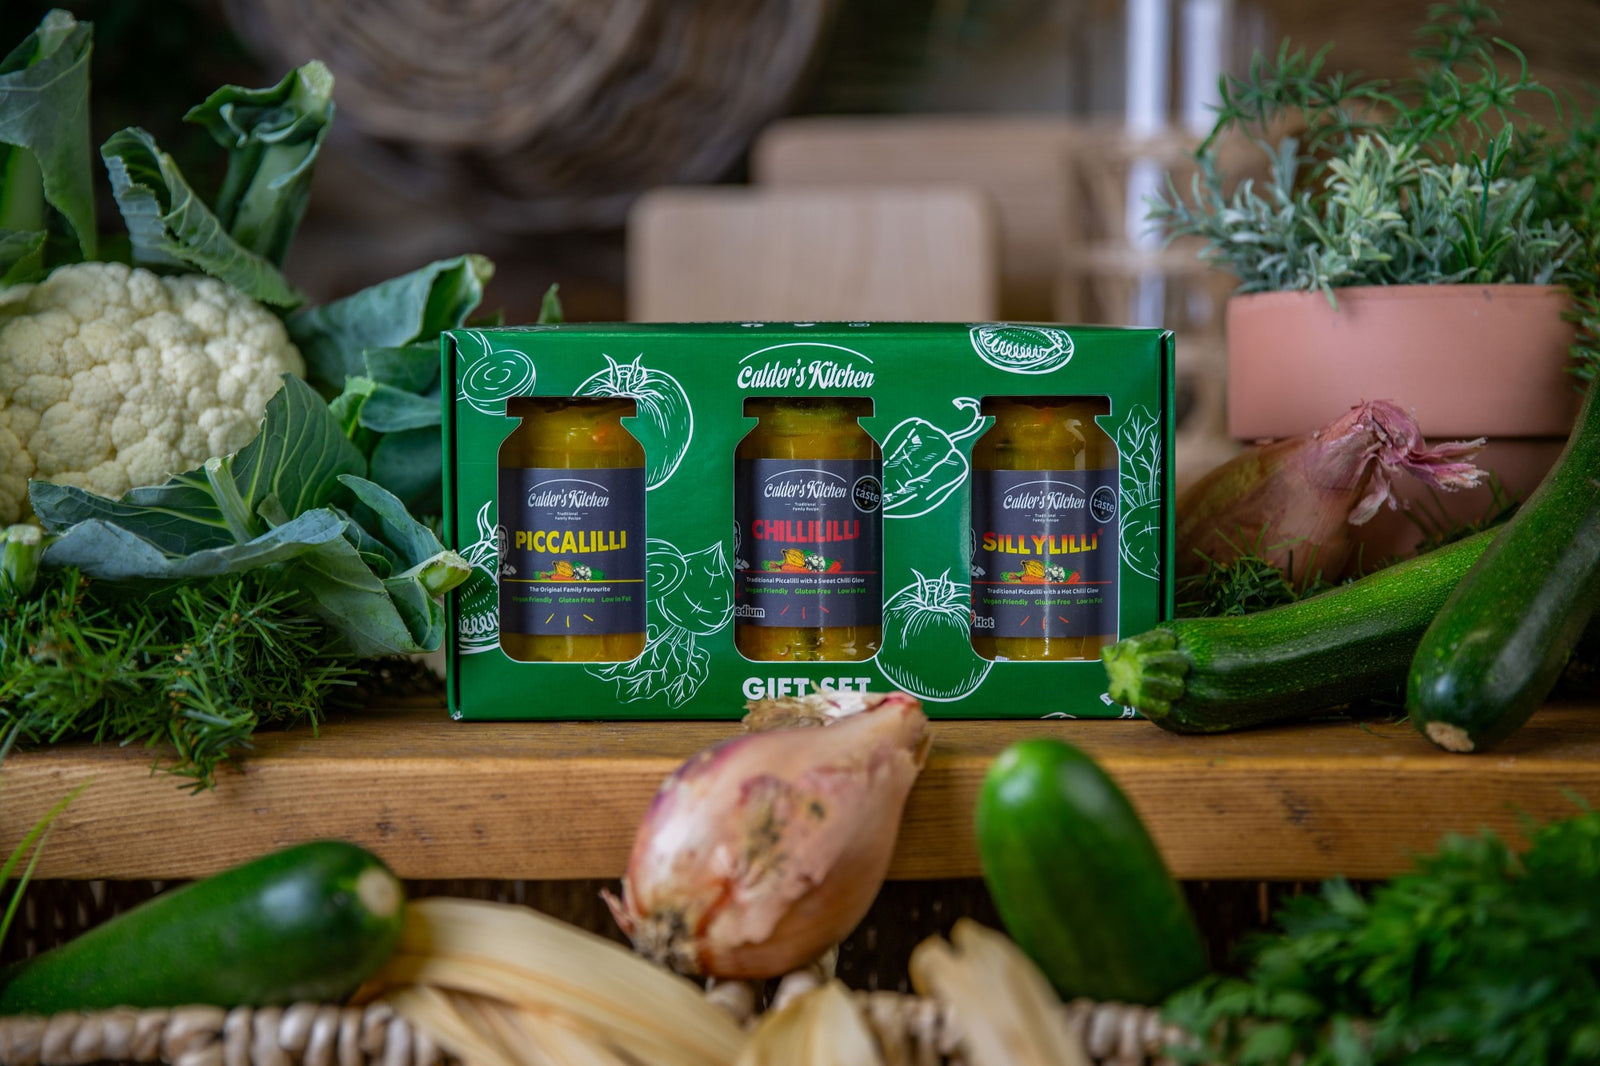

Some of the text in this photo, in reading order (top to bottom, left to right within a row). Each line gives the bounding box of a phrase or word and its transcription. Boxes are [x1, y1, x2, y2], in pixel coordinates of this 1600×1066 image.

[737, 358, 875, 390] Calder's Kitchen
[764, 479, 806, 498] Calder's
[806, 480, 847, 499] Kitchen
[855, 486, 880, 503] taste
[528, 488, 609, 508] Calder's Kitchen
[1003, 491, 1045, 510] Calder's
[1046, 491, 1086, 510] Kitchen
[1093, 497, 1115, 513] taste
[515, 530, 627, 554] PICCALILLI
[540, 586, 562, 594] Original
[528, 596, 553, 604] Friendly
[1002, 598, 1029, 606] Friendly
[735, 605, 765, 618] edium
[974, 617, 995, 628] Hot
[742, 677, 809, 700] GIFT
